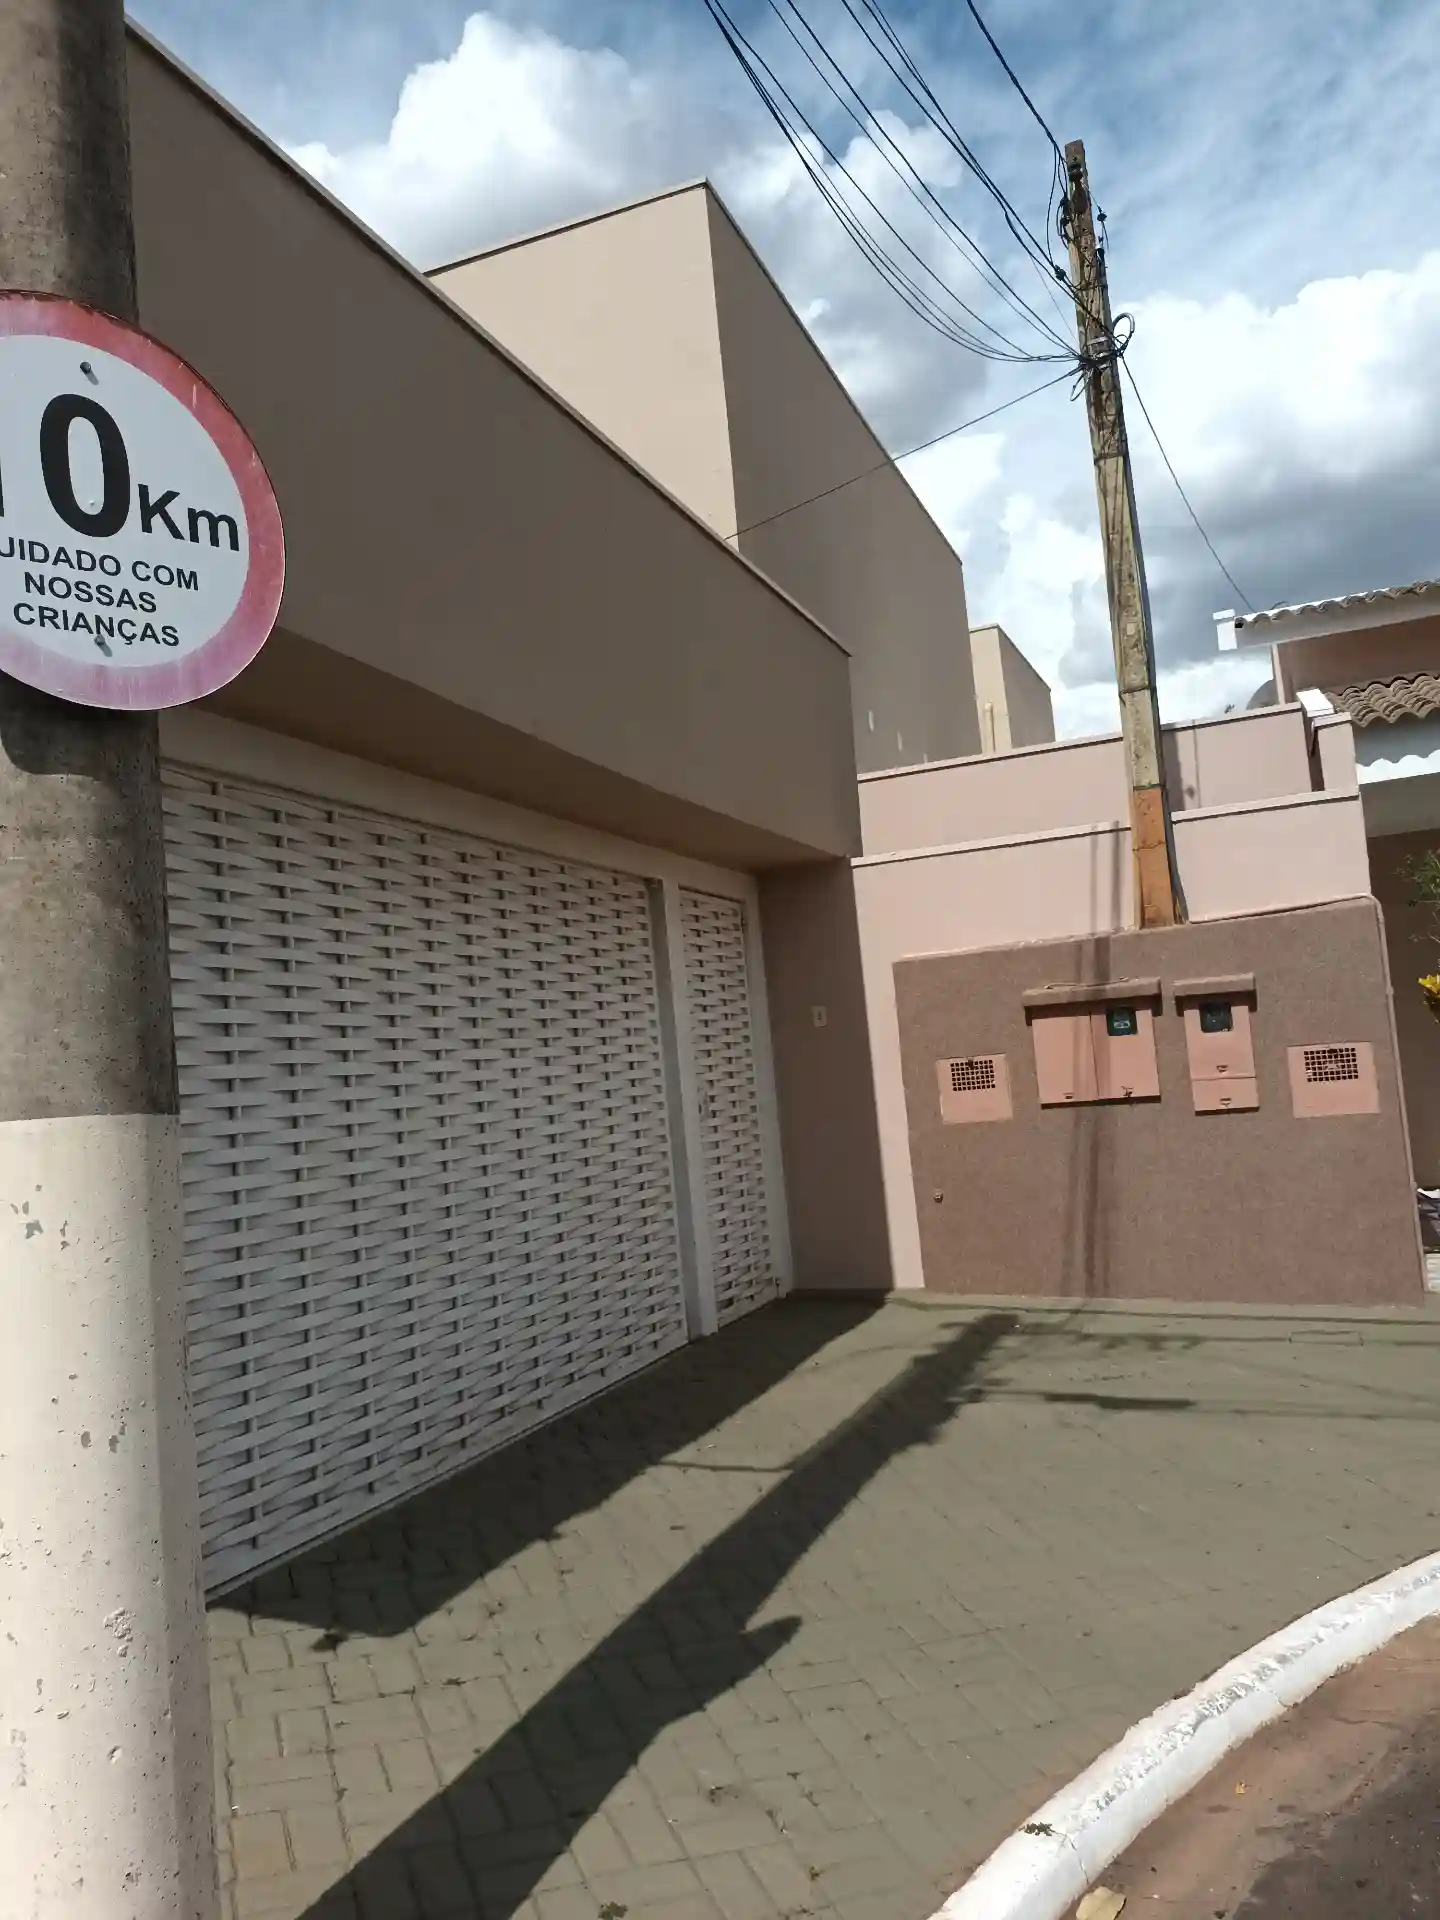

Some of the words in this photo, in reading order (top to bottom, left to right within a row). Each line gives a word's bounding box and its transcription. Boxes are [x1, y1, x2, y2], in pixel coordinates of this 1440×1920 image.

[24, 571, 157, 613] NOSSAS
[131, 560, 199, 591] COM
[13, 602, 180, 647] CRIANÇAS
